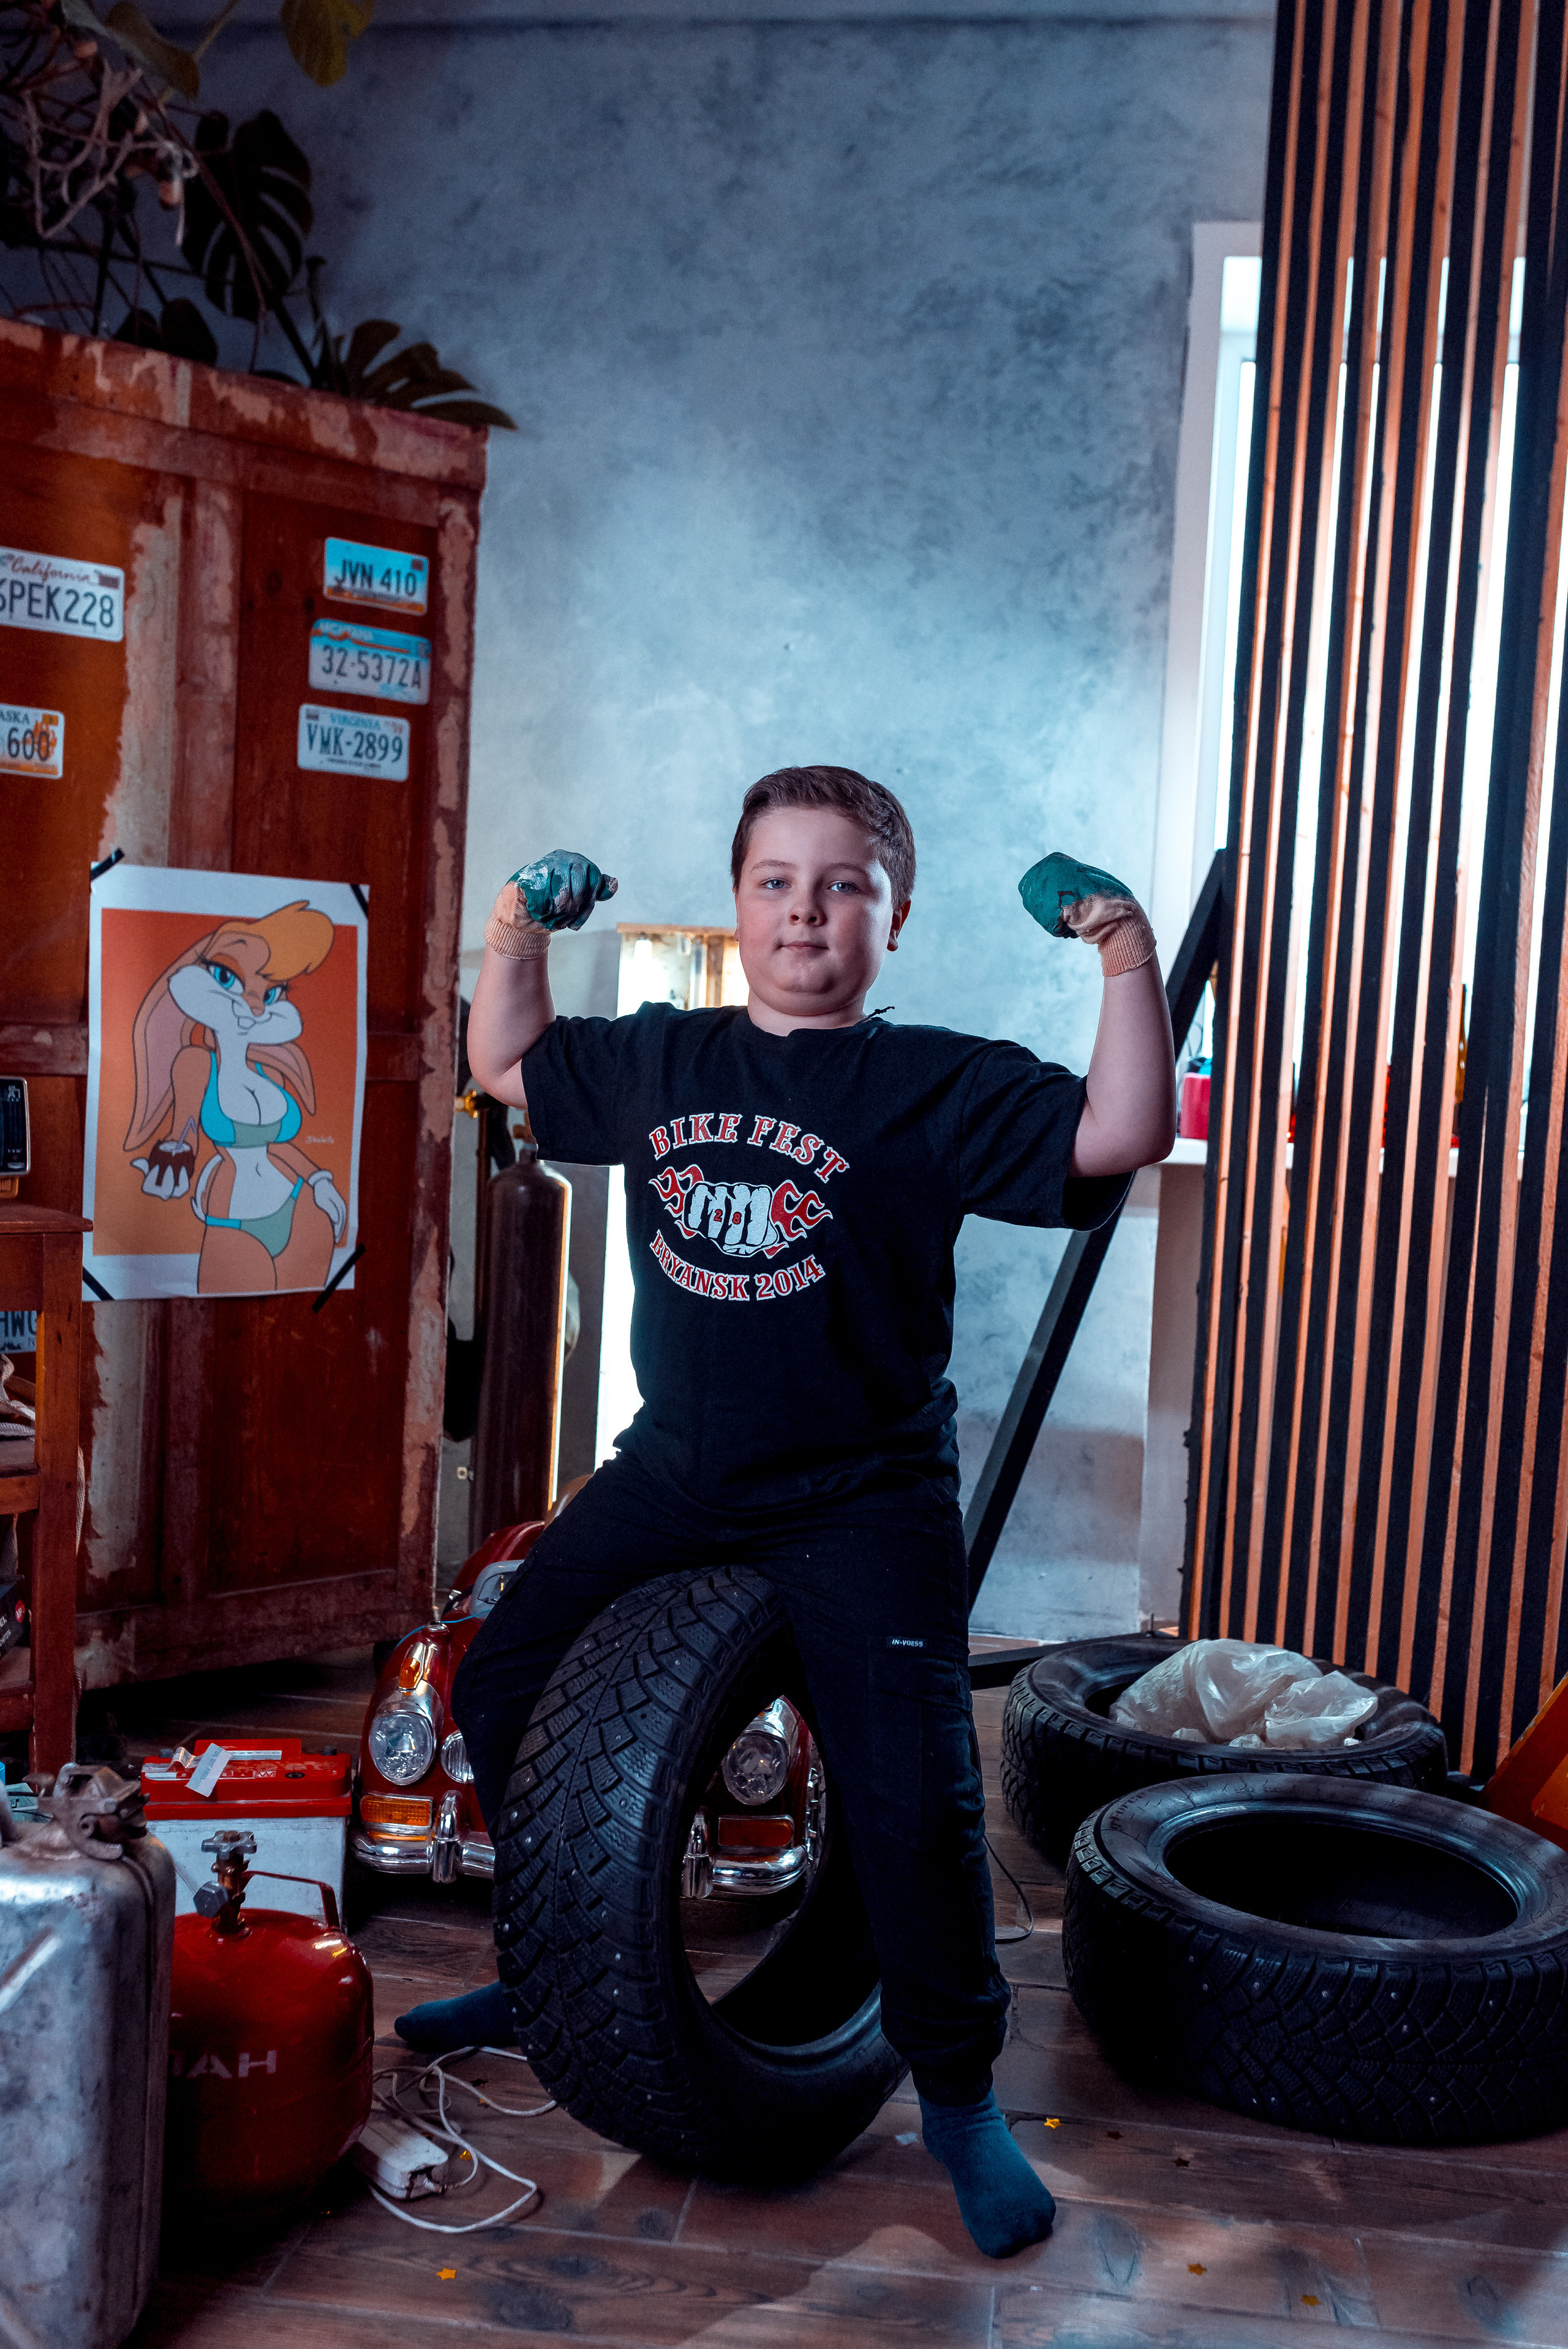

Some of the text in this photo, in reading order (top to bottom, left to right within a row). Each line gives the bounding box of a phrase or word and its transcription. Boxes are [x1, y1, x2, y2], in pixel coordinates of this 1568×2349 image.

[334, 558, 374, 589] JVN
[379, 567, 417, 597] 410
[322, 645, 422, 690] 32-5372A
[7, 727, 50, 762] 600
[649, 1113, 850, 1184] BIKE FEST
[649, 1228, 827, 1301] BRYANSK 2014
[173, 2050, 277, 2079] АН
